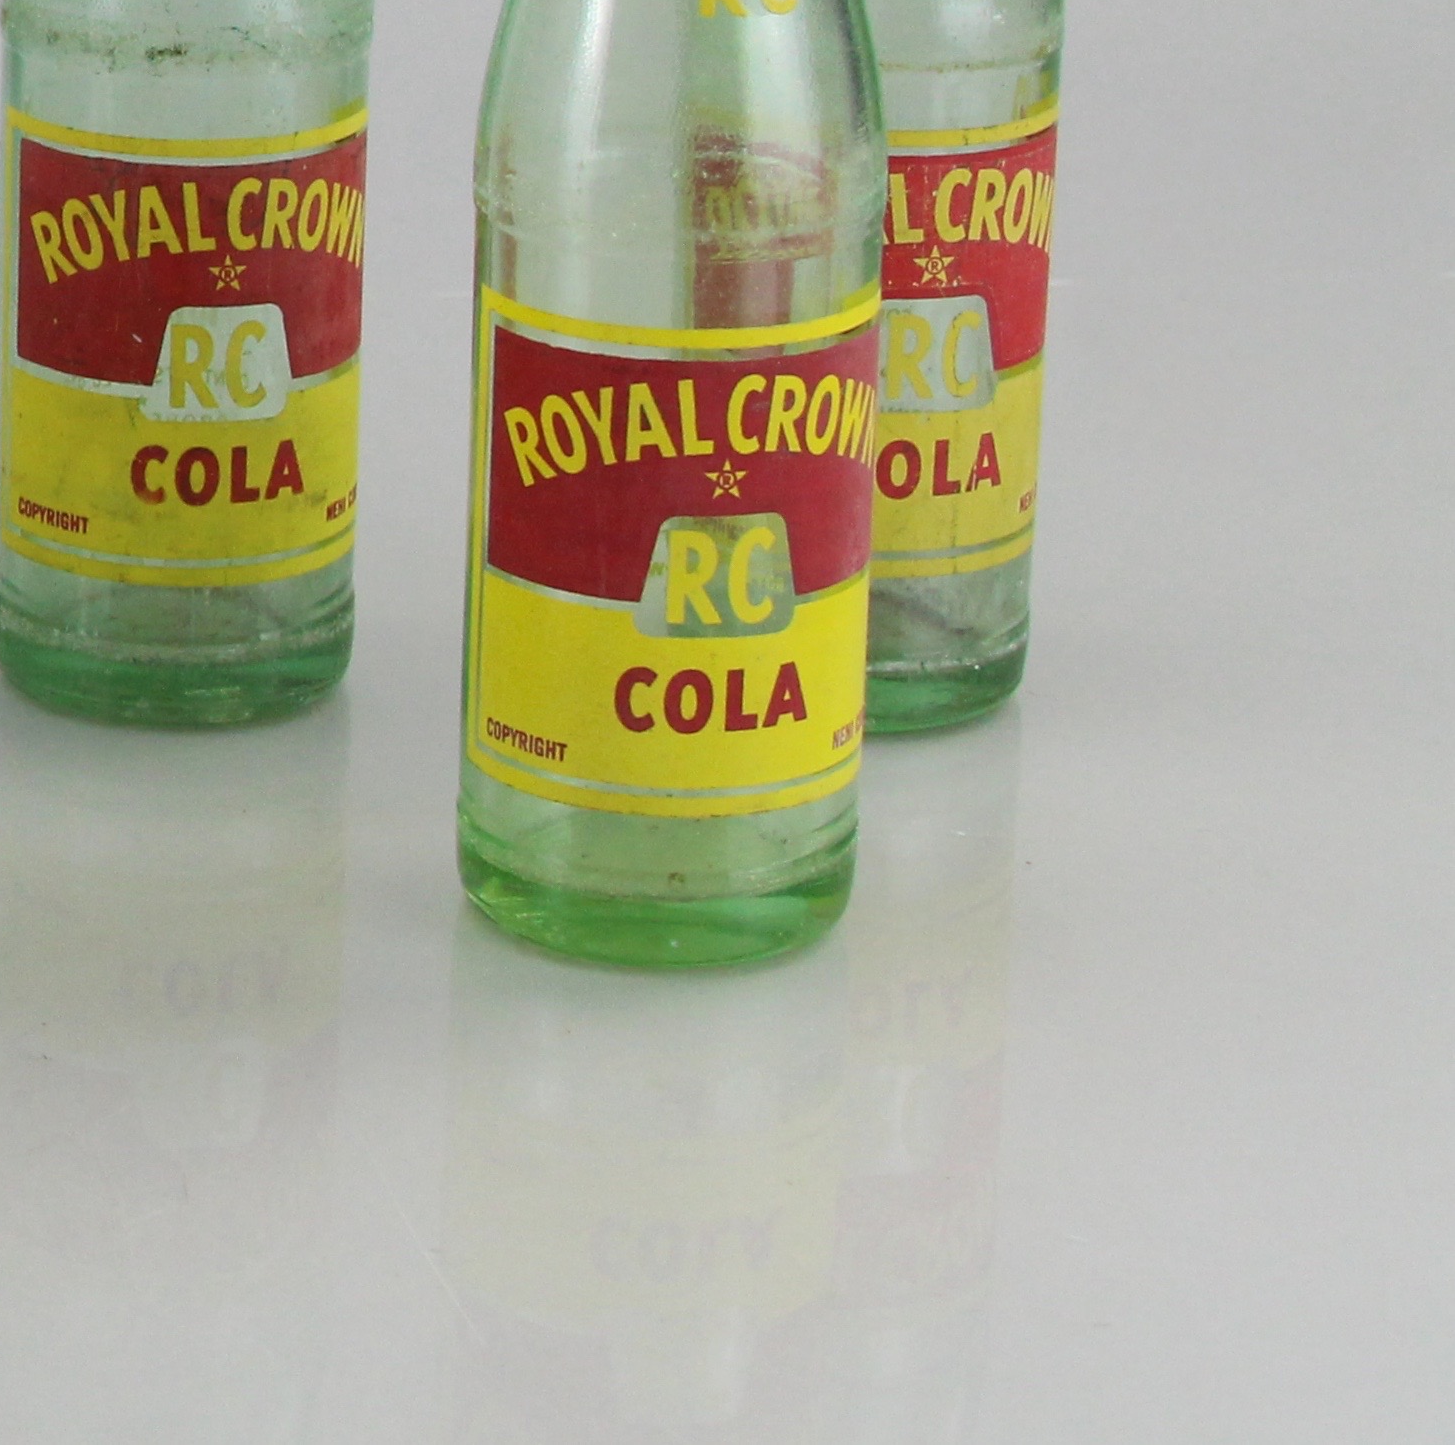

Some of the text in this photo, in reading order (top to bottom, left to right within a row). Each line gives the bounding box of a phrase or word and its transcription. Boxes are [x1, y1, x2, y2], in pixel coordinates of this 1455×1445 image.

[30, 178, 364, 284] ROYAL CROWN
[935, 168, 1053, 253] CROW
[169, 320, 267, 408] RC
[890, 310, 979, 397] RC
[130, 439, 304, 506] COLA
[504, 374, 876, 487] ROYAL CROWN
[876, 433, 1000, 499] OLA
[18, 496, 89, 535] COPYRIGHT
[666, 527, 777, 624] RC
[486, 717, 567, 763] COPYRIGHT
[614, 662, 808, 733] COLA
